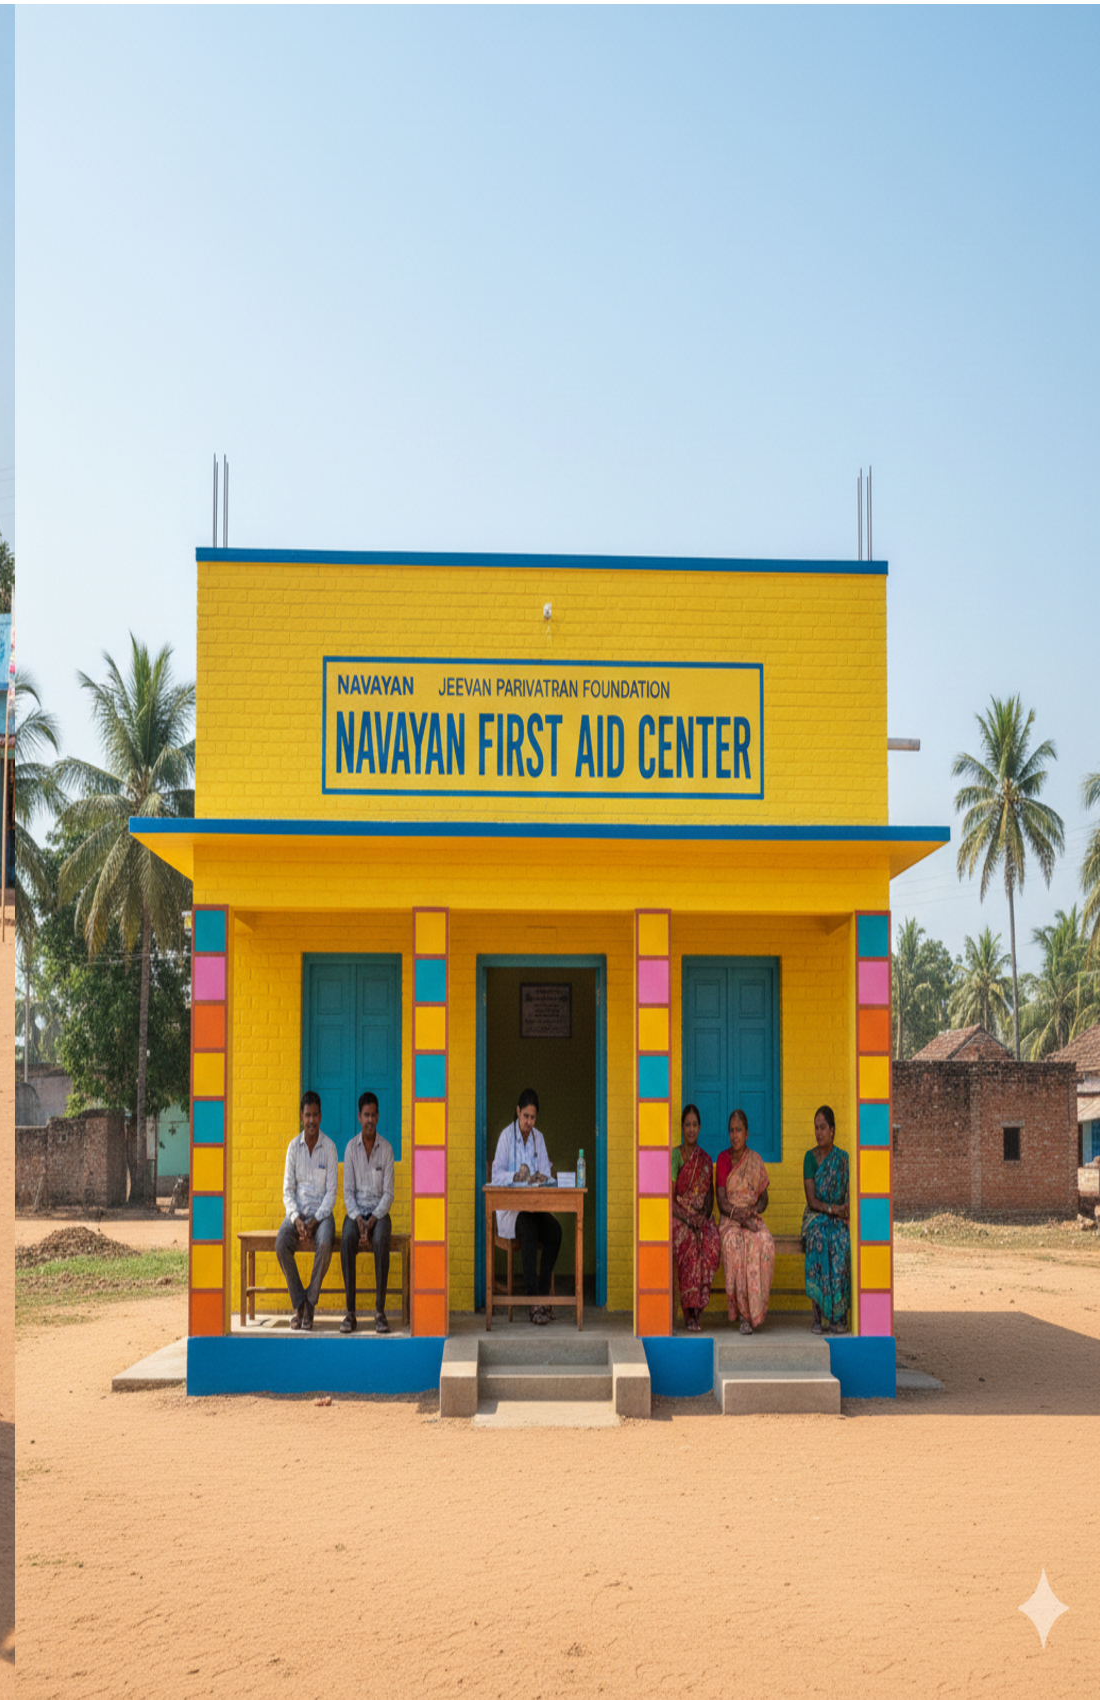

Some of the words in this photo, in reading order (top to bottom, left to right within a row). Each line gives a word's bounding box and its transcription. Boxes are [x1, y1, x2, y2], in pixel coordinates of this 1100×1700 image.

[337, 674, 414, 696] NAVAYAN
[438, 676, 492, 697] JEEVAN
[496, 678, 579, 698] PARIVATRAN
[582, 679, 671, 699] FOUNDATION
[335, 710, 466, 776] NAVAYAN
[478, 712, 563, 779] FIRST
[574, 714, 626, 779] AID
[638, 715, 752, 780] CENTER
